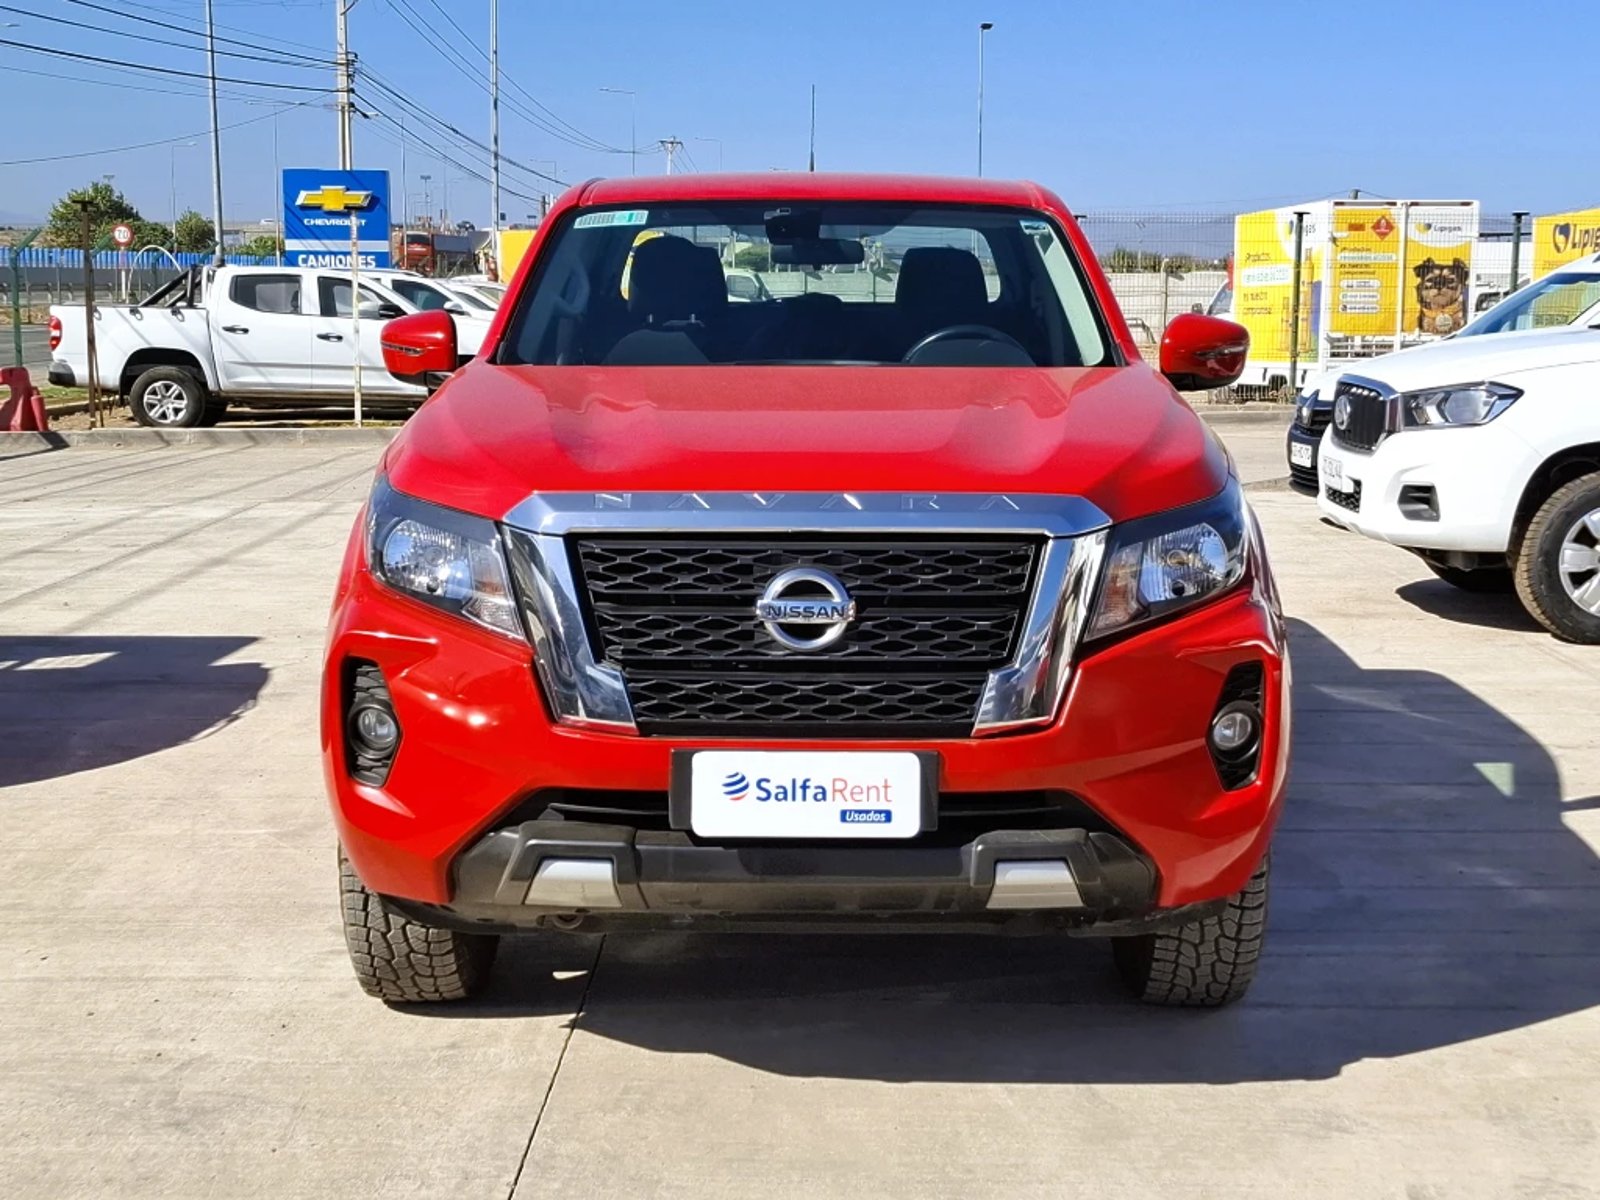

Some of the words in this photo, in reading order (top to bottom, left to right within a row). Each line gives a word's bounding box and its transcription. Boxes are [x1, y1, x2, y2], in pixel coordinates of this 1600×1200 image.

[303, 218, 367, 226] CHEVROLT
[117, 229, 129, 239] 70
[593, 491, 1020, 510] NAVARA
[764, 604, 847, 620] NISSAN
[844, 810, 886, 822] Usados
